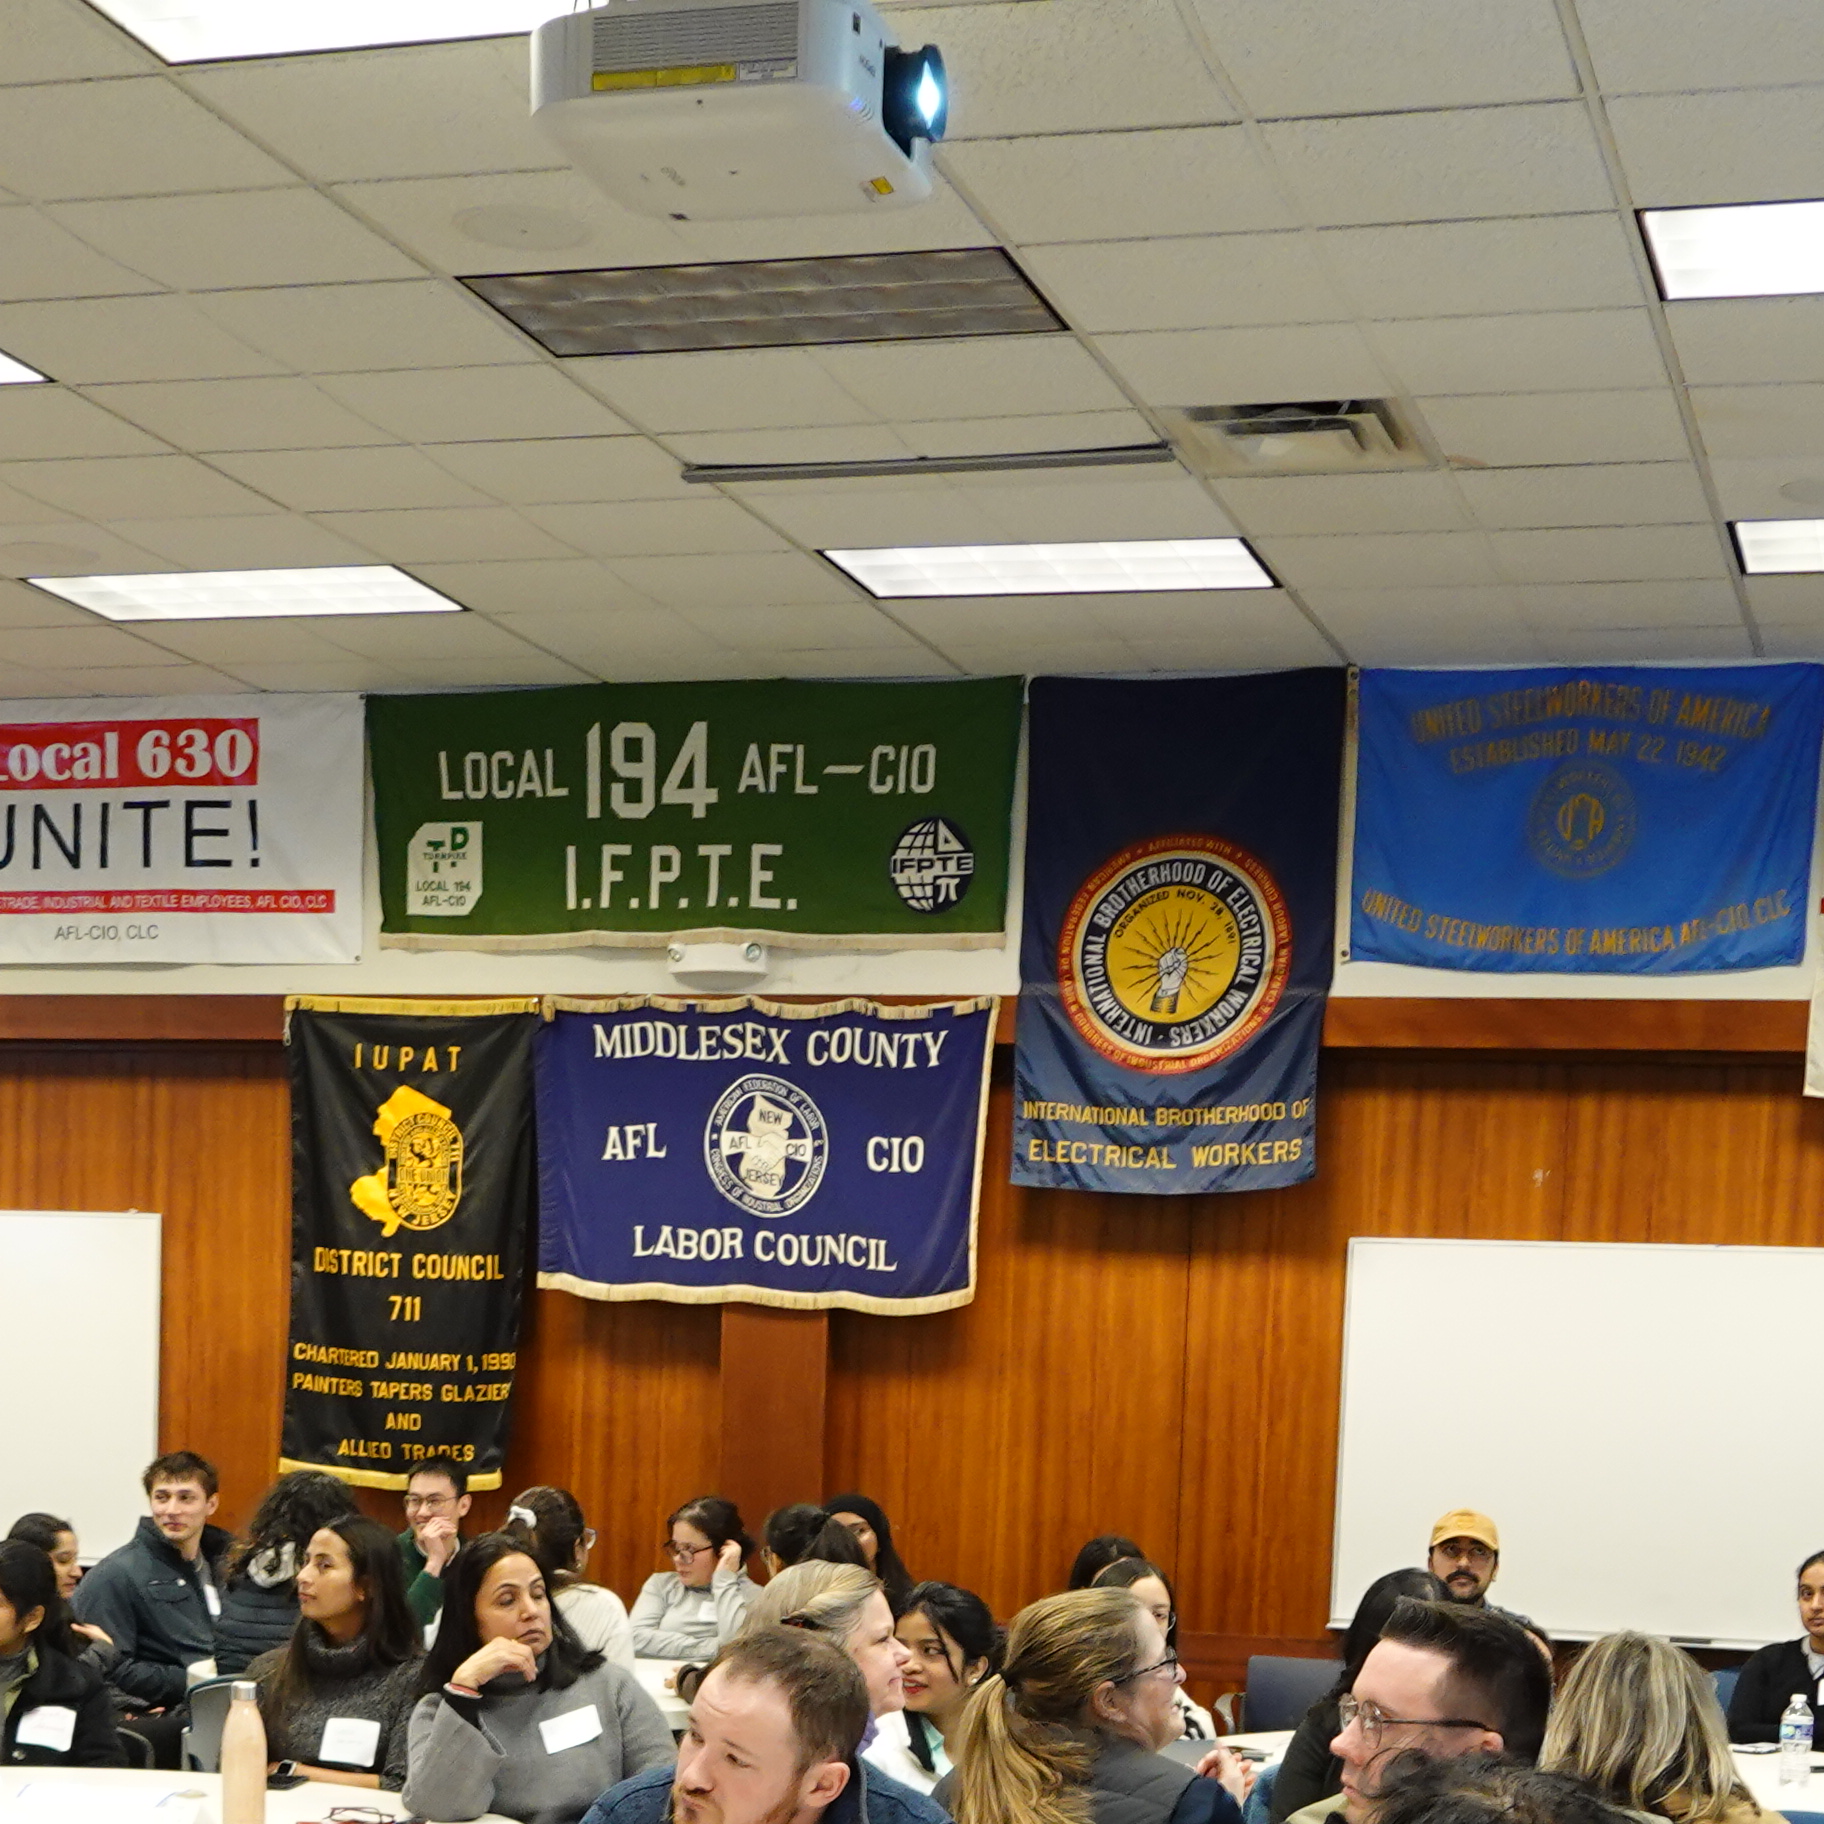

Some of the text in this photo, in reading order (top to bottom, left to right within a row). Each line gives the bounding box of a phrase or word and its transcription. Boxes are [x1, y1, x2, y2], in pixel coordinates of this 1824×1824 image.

[1411, 681, 1770, 744] UNITED STEELWORKERS OF AMERICA
[136, 728, 254, 779] 630
[1451, 728, 1578, 773] ESTABLISHED
[1588, 729, 1630, 756] MAY
[1677, 740, 1727, 772] 1942
[438, 749, 569, 801] LOCAL
[586, 721, 719, 820] 194
[566, 844, 799, 910] I.F.P.T.E.
[890, 854, 974, 875] IFPTE
[134, 894, 179, 909] TEXTILE
[415, 880, 448, 892] LOCAL
[1114, 889, 1170, 939] ORGANIZED
[1362, 890, 1420, 932] UNITED
[1423, 912, 1560, 954] STEELWORKERS
[1565, 928, 1585, 955] OF
[1588, 925, 1674, 955] AMERICA
[126, 923, 160, 941] CLC
[1084, 862, 1264, 1048] INTERNATIONAL BROTHERHOOD OF ELECTRICAL WORKERS
[592, 1022, 950, 1069] MIDDLESEX COUNTY
[759, 1109, 783, 1125] NEW
[799, 1103, 821, 1131] LABOR
[1022, 1098, 1312, 1127] INTERNATIONAL BROTHERHOOD OF
[601, 1122, 667, 1161] AFL
[729, 1135, 752, 1150] AFL
[785, 1143, 807, 1157] CIO
[866, 1135, 925, 1174] CIO
[1028, 1137, 1303, 1170] ELECTRICAL WORKERS
[745, 1169, 783, 1187] JERSEY
[314, 1246, 505, 1282] DISTRICT COUNCIL
[632, 1224, 898, 1273] LABOR COUNCIL
[387, 1295, 422, 1323] 711
[293, 1341, 379, 1369] CHARTERED
[384, 1350, 461, 1373] JANUARY
[465, 1351, 479, 1376] 1,
[292, 1371, 364, 1400] PAINTERS
[368, 1379, 433, 1402] TAPERS
[385, 1412, 422, 1433] AND
[337, 1438, 391, 1462] ALLIED
